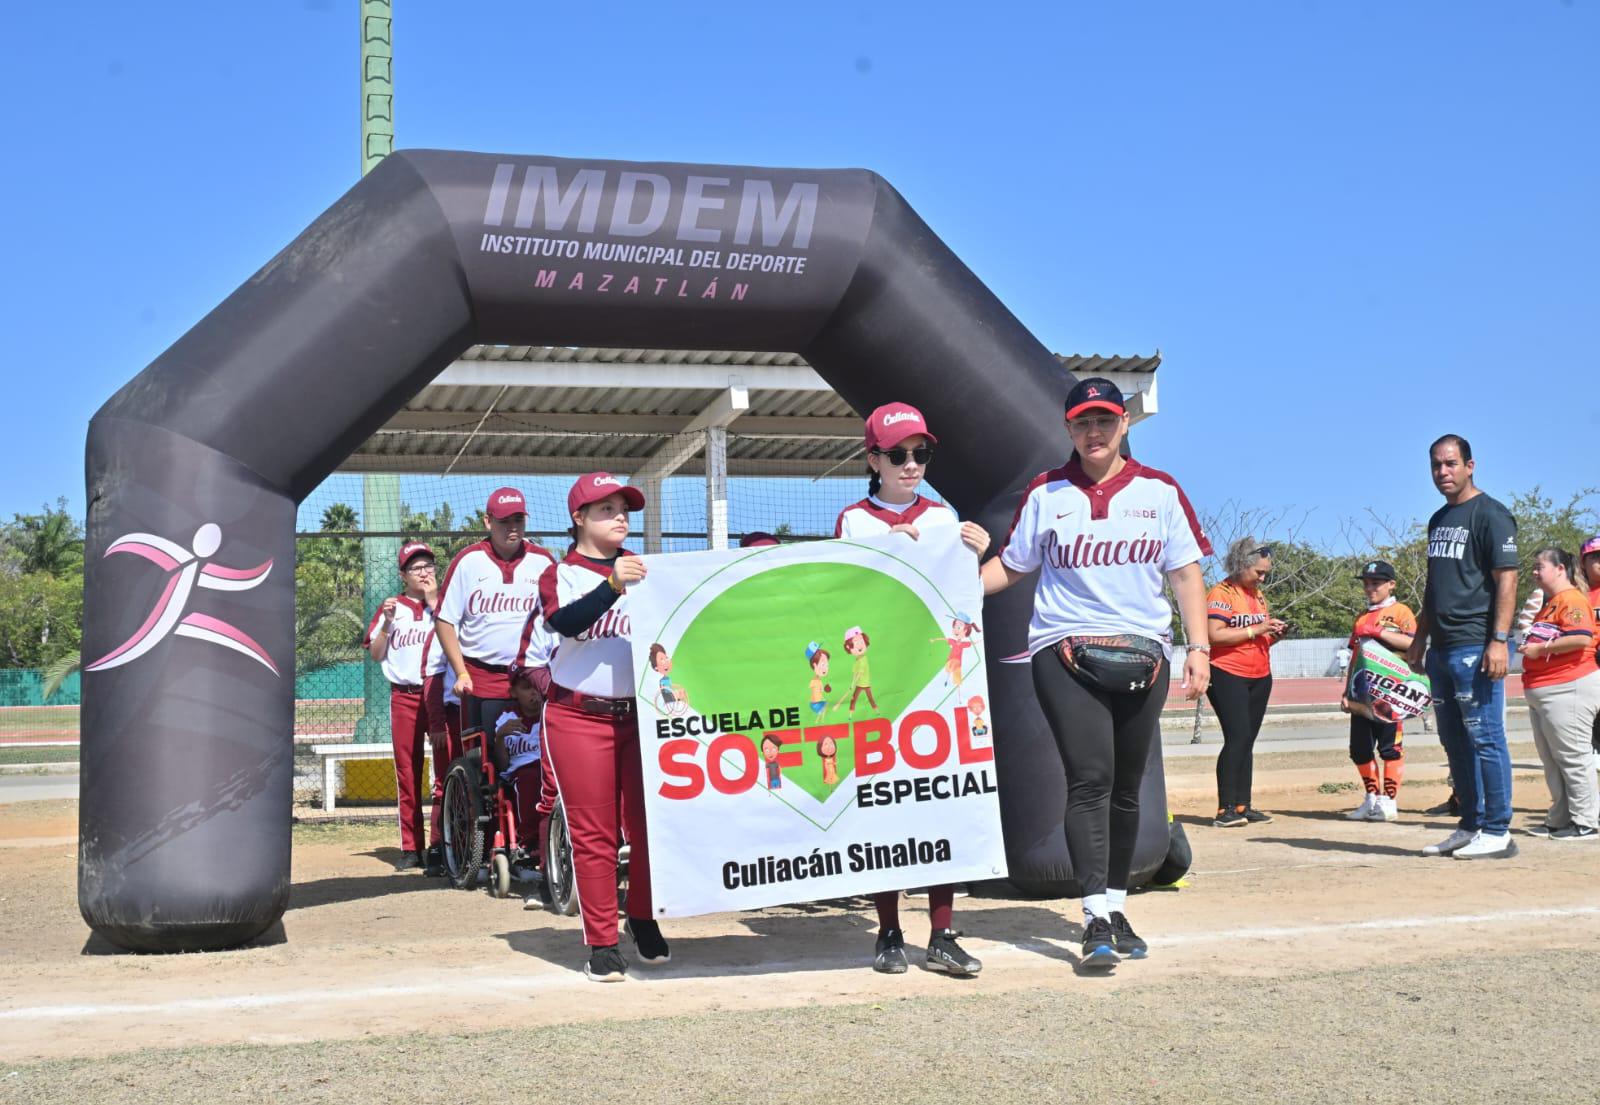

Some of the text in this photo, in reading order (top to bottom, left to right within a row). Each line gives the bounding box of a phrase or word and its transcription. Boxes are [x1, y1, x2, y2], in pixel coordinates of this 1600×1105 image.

[483, 163, 819, 249] IMDEM
[480, 233, 806, 274] INSTITUTO MUNICIPAL DEL DEPORTE
[1047, 530, 1162, 569] Culiacán
[656, 707, 800, 738] ESCUELA DE
[658, 706, 994, 800] SOFTBOL
[857, 770, 997, 808] ESPECIAL
[722, 838, 951, 890] Culiacán Sinaloa
